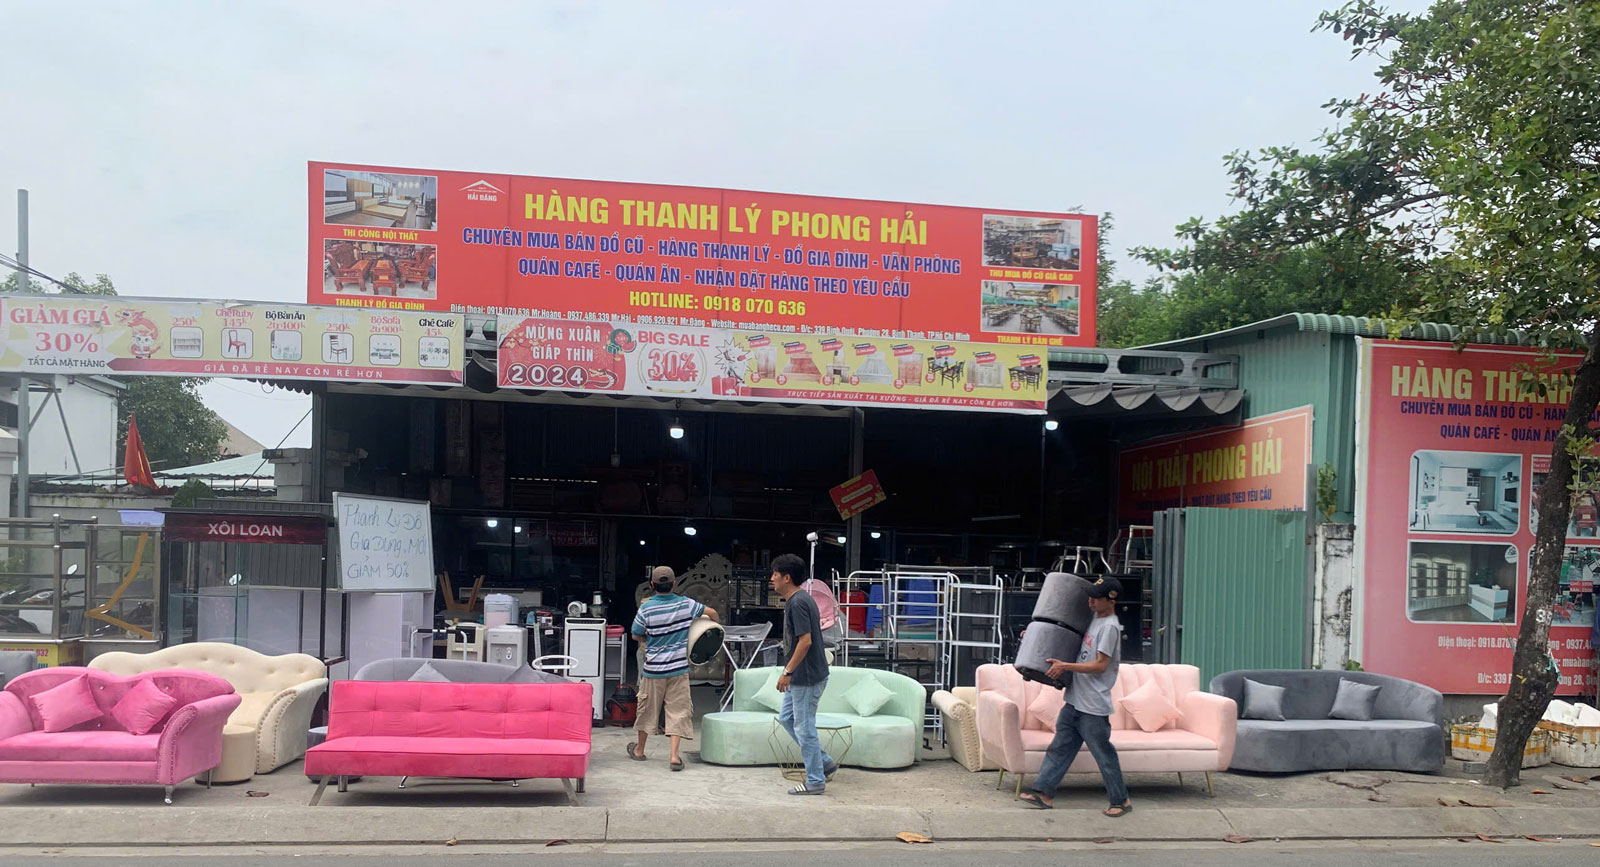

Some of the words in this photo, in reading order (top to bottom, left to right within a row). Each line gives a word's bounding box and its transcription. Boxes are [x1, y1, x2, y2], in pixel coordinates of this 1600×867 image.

[525, 189, 609, 224] HÀNG
[619, 200, 718, 231] THANH
[729, 203, 762, 234] LÝ
[772, 210, 870, 242] PHONG
[880, 211, 928, 245] HẢI
[343, 228, 356, 237] THI
[358, 228, 380, 239] CÔNG
[382, 230, 396, 240] NỘI
[399, 231, 418, 240] THẤT
[463, 226, 522, 247] CHUYÊN
[527, 232, 560, 249] MUA
[565, 231, 595, 251] BÁN
[600, 232, 620, 252] ĐỒ
[624, 235, 644, 254] CŨ
[658, 237, 698, 258] HÀNG
[702, 242, 750, 261] THANH
[754, 243, 770, 262] LÝ
[808, 250, 831, 266] GIA
[835, 249, 869, 269] ĐÌNH
[882, 252, 910, 272] VĂN
[914, 253, 961, 274] PHÒNG
[518, 256, 559, 276] QUÁN
[564, 260, 600, 279] CAFÉ
[615, 263, 655, 282] QUÁN
[660, 264, 680, 283] ĂN
[695, 267, 735, 290] NHẬN
[740, 269, 767, 292] ĐẶT
[771, 272, 809, 292] HÀNG
[813, 276, 848, 295] THEO
[853, 276, 878, 296] YÊU
[882, 276, 910, 298] CẦU
[336, 298, 362, 306] THANH
[364, 299, 374, 308] LÝ
[629, 291, 699, 310] HOTLINE:
[703, 295, 741, 312] 0918
[745, 298, 774, 314] 070
[778, 301, 806, 316] 636
[10, 304, 70, 325] GIẢM
[73, 306, 111, 326] GIÁ
[265, 311, 277, 321] Bộ
[278, 311, 293, 320] Bàn
[712, 319, 738, 329] Website:
[35, 332, 99, 353] 30%
[525, 323, 563, 341] MỪNG
[568, 325, 601, 343] XUÂN
[638, 330, 667, 345] BIG
[668, 332, 710, 348] SALE
[28, 355, 46, 366] TẤT
[46, 356, 59, 367] CẢ
[59, 358, 80, 369] MẶT
[80, 358, 106, 368] HÀNG
[532, 344, 560, 361] GIÁP
[566, 345, 594, 362] THÌN
[204, 364, 226, 372] GIÁ
[232, 364, 248, 373] ĐÃ
[275, 366, 300, 374] NAY
[305, 366, 330, 376] CÒN
[357, 370, 384, 378] HƠN
[510, 364, 585, 385] 2024
[648, 347, 697, 382] 30%
[1391, 360, 1473, 400] HÀNG
[1401, 400, 1444, 416] CHUYÊN
[1448, 403, 1472, 416] MUA
[1475, 401, 1498, 418] BÁN
[1544, 405, 1566, 420] HÀN
[1440, 422, 1470, 439] QUÁN
[1474, 424, 1500, 440] CAFÉ
[1512, 426, 1540, 442] QUÁN
[1192, 444, 1246, 485] PHONG
[1251, 426, 1283, 477] HẢI
[208, 520, 236, 536] XÔI
[240, 524, 284, 537] LOAN
[347, 555, 380, 579] GIẢM
[386, 561, 410, 578] 50%
[1494, 673, 1506, 684] 339
